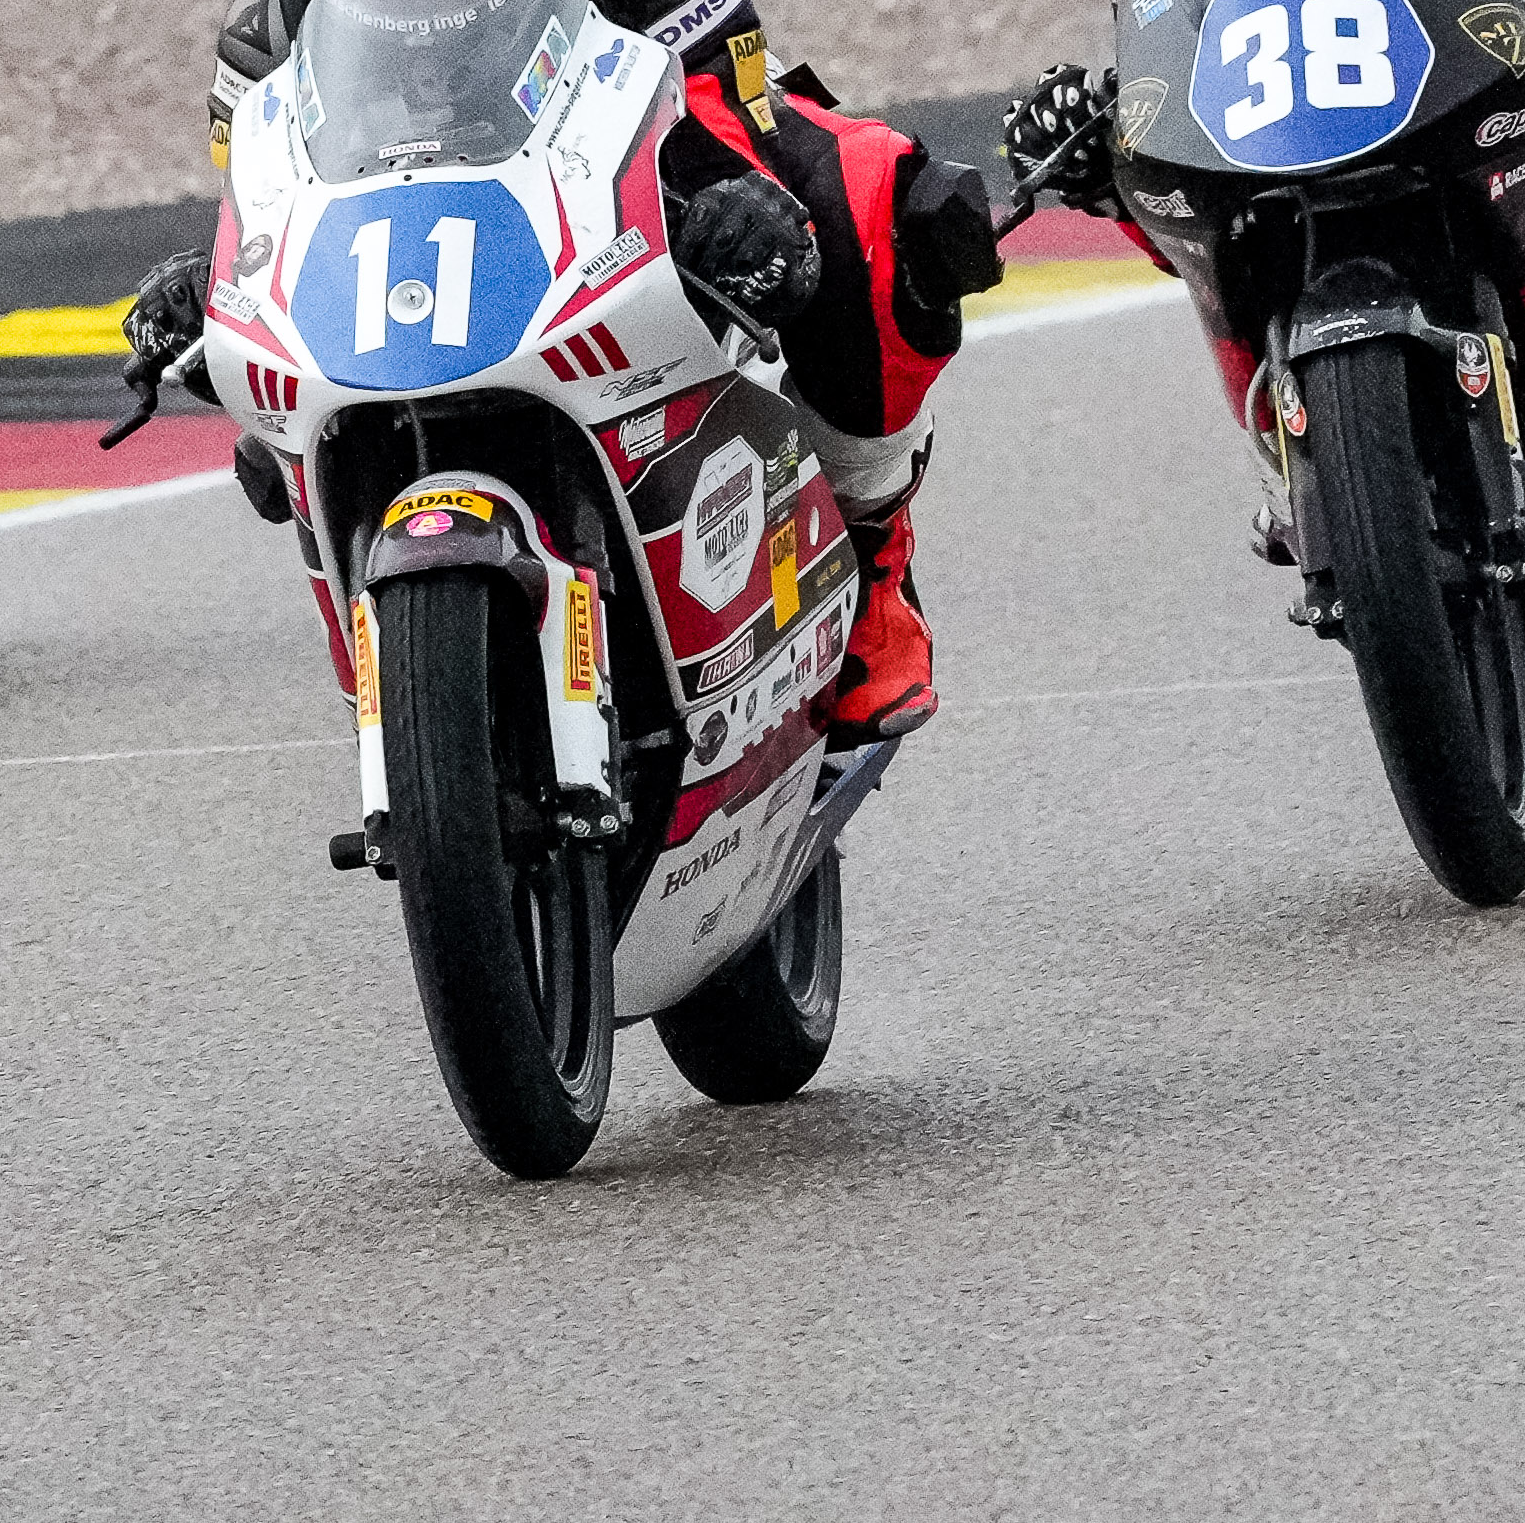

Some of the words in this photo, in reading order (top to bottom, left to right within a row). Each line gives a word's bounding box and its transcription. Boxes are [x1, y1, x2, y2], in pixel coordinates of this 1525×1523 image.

[382, 143, 438, 157] HONDA
[350, 217, 477, 355] 11
[397, 494, 474, 516] ADAC
[660, 827, 742, 900] HONDA
